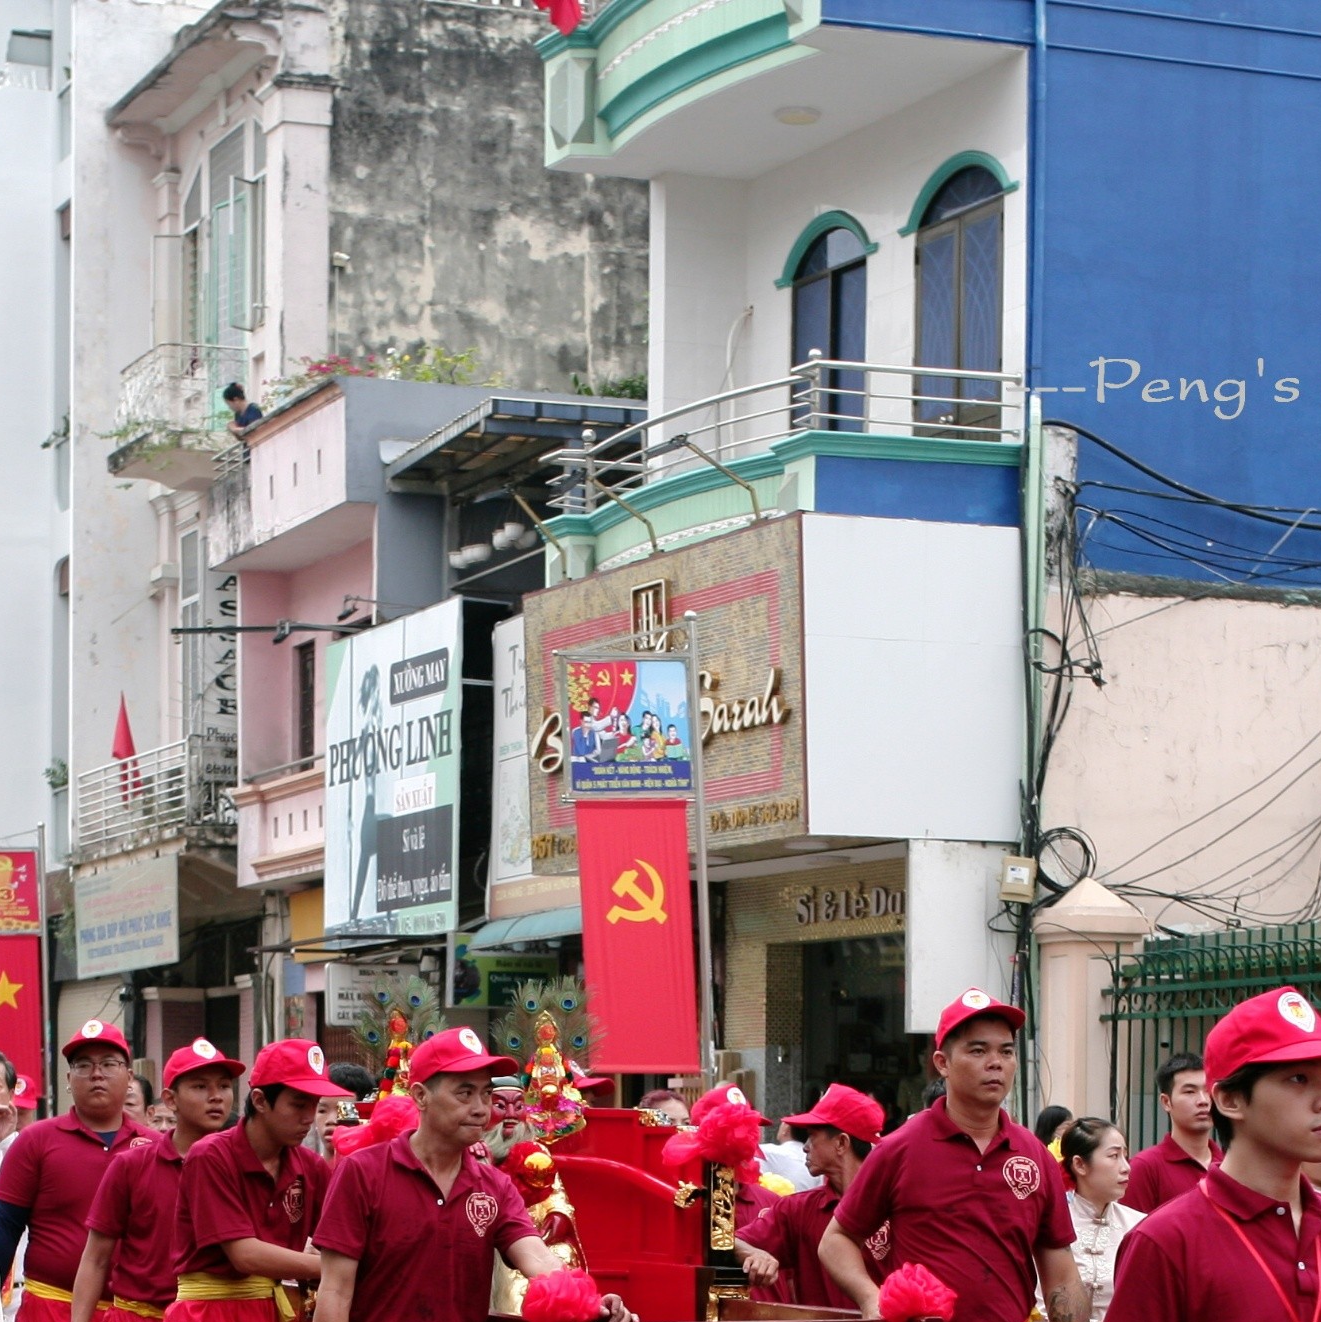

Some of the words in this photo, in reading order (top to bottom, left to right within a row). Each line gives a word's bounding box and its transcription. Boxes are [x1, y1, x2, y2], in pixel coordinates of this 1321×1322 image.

[393, 662, 424, 695] XƯỞNG
[425, 658, 447, 687] MAY
[329, 723, 403, 787] PHƯƠNG
[406, 709, 453, 766] LINH
[395, 787, 411, 813] SẢN
[822, 890, 835, 922] &
